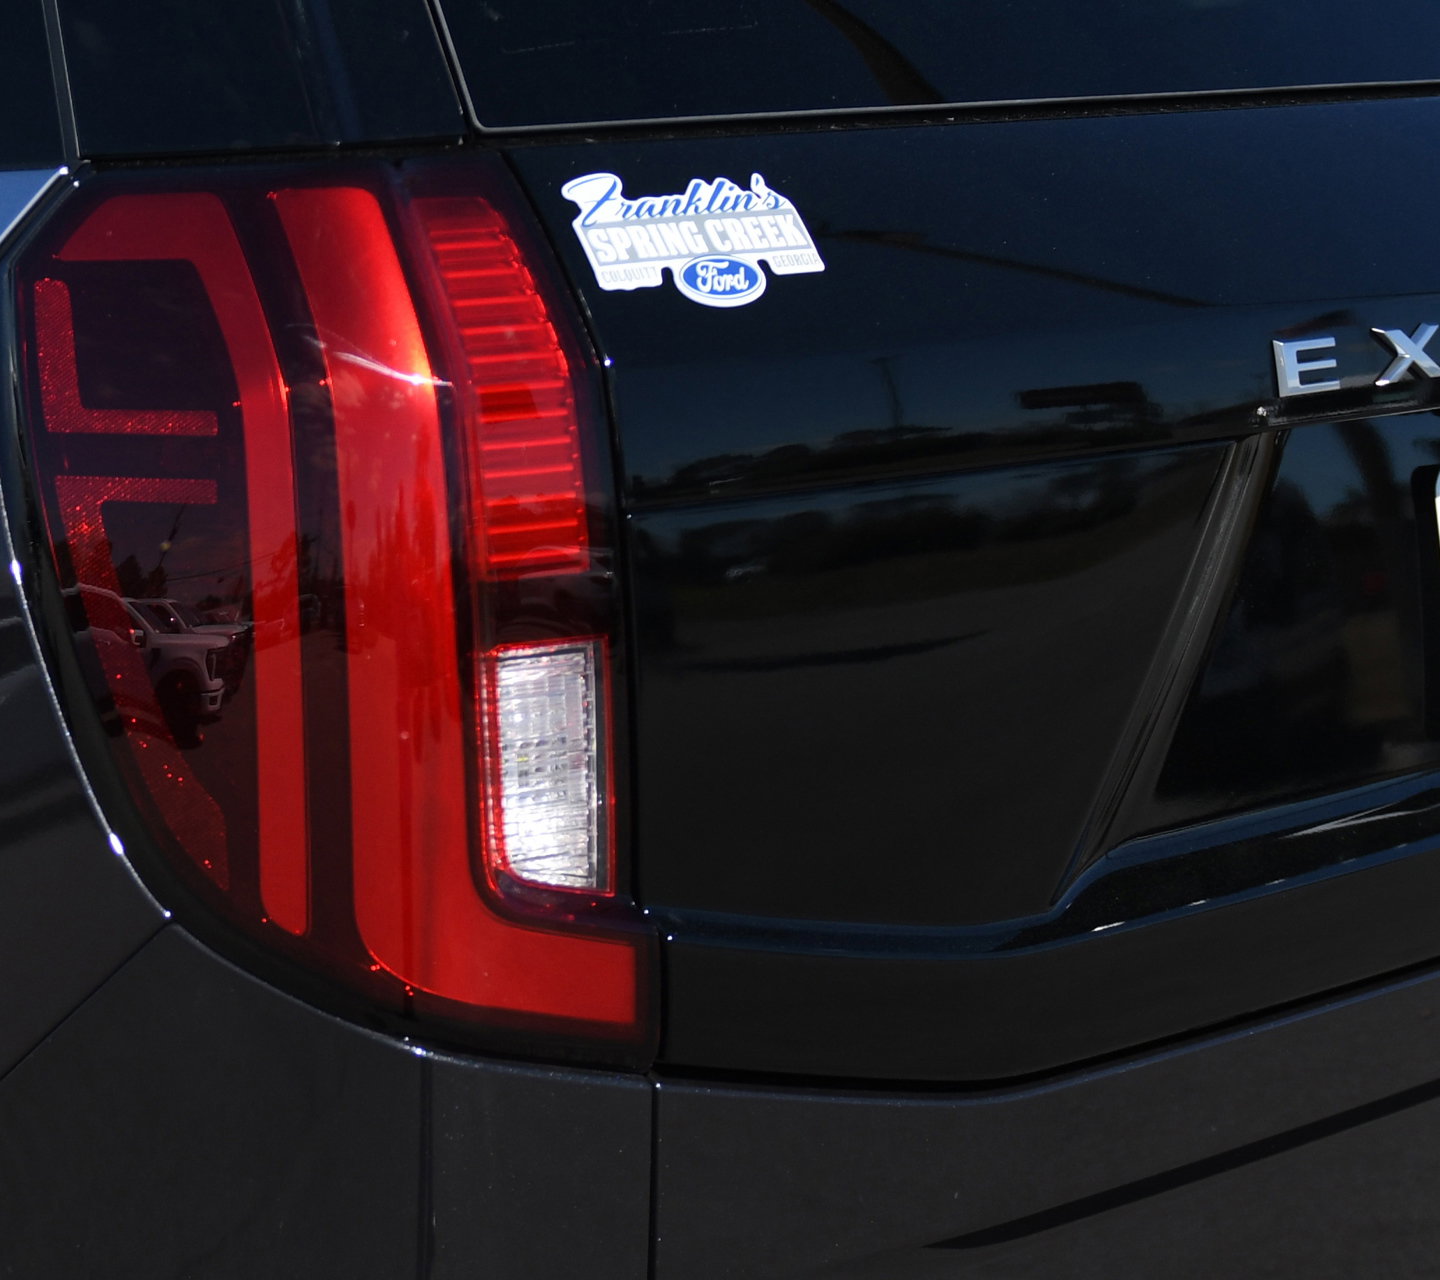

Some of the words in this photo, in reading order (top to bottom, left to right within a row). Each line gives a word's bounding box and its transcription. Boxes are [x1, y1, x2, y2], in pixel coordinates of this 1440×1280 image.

[566, 175, 787, 227] Franklin's
[587, 222, 705, 263] SPRING
[705, 213, 809, 253] CREEK
[695, 260, 749, 294] Ford
